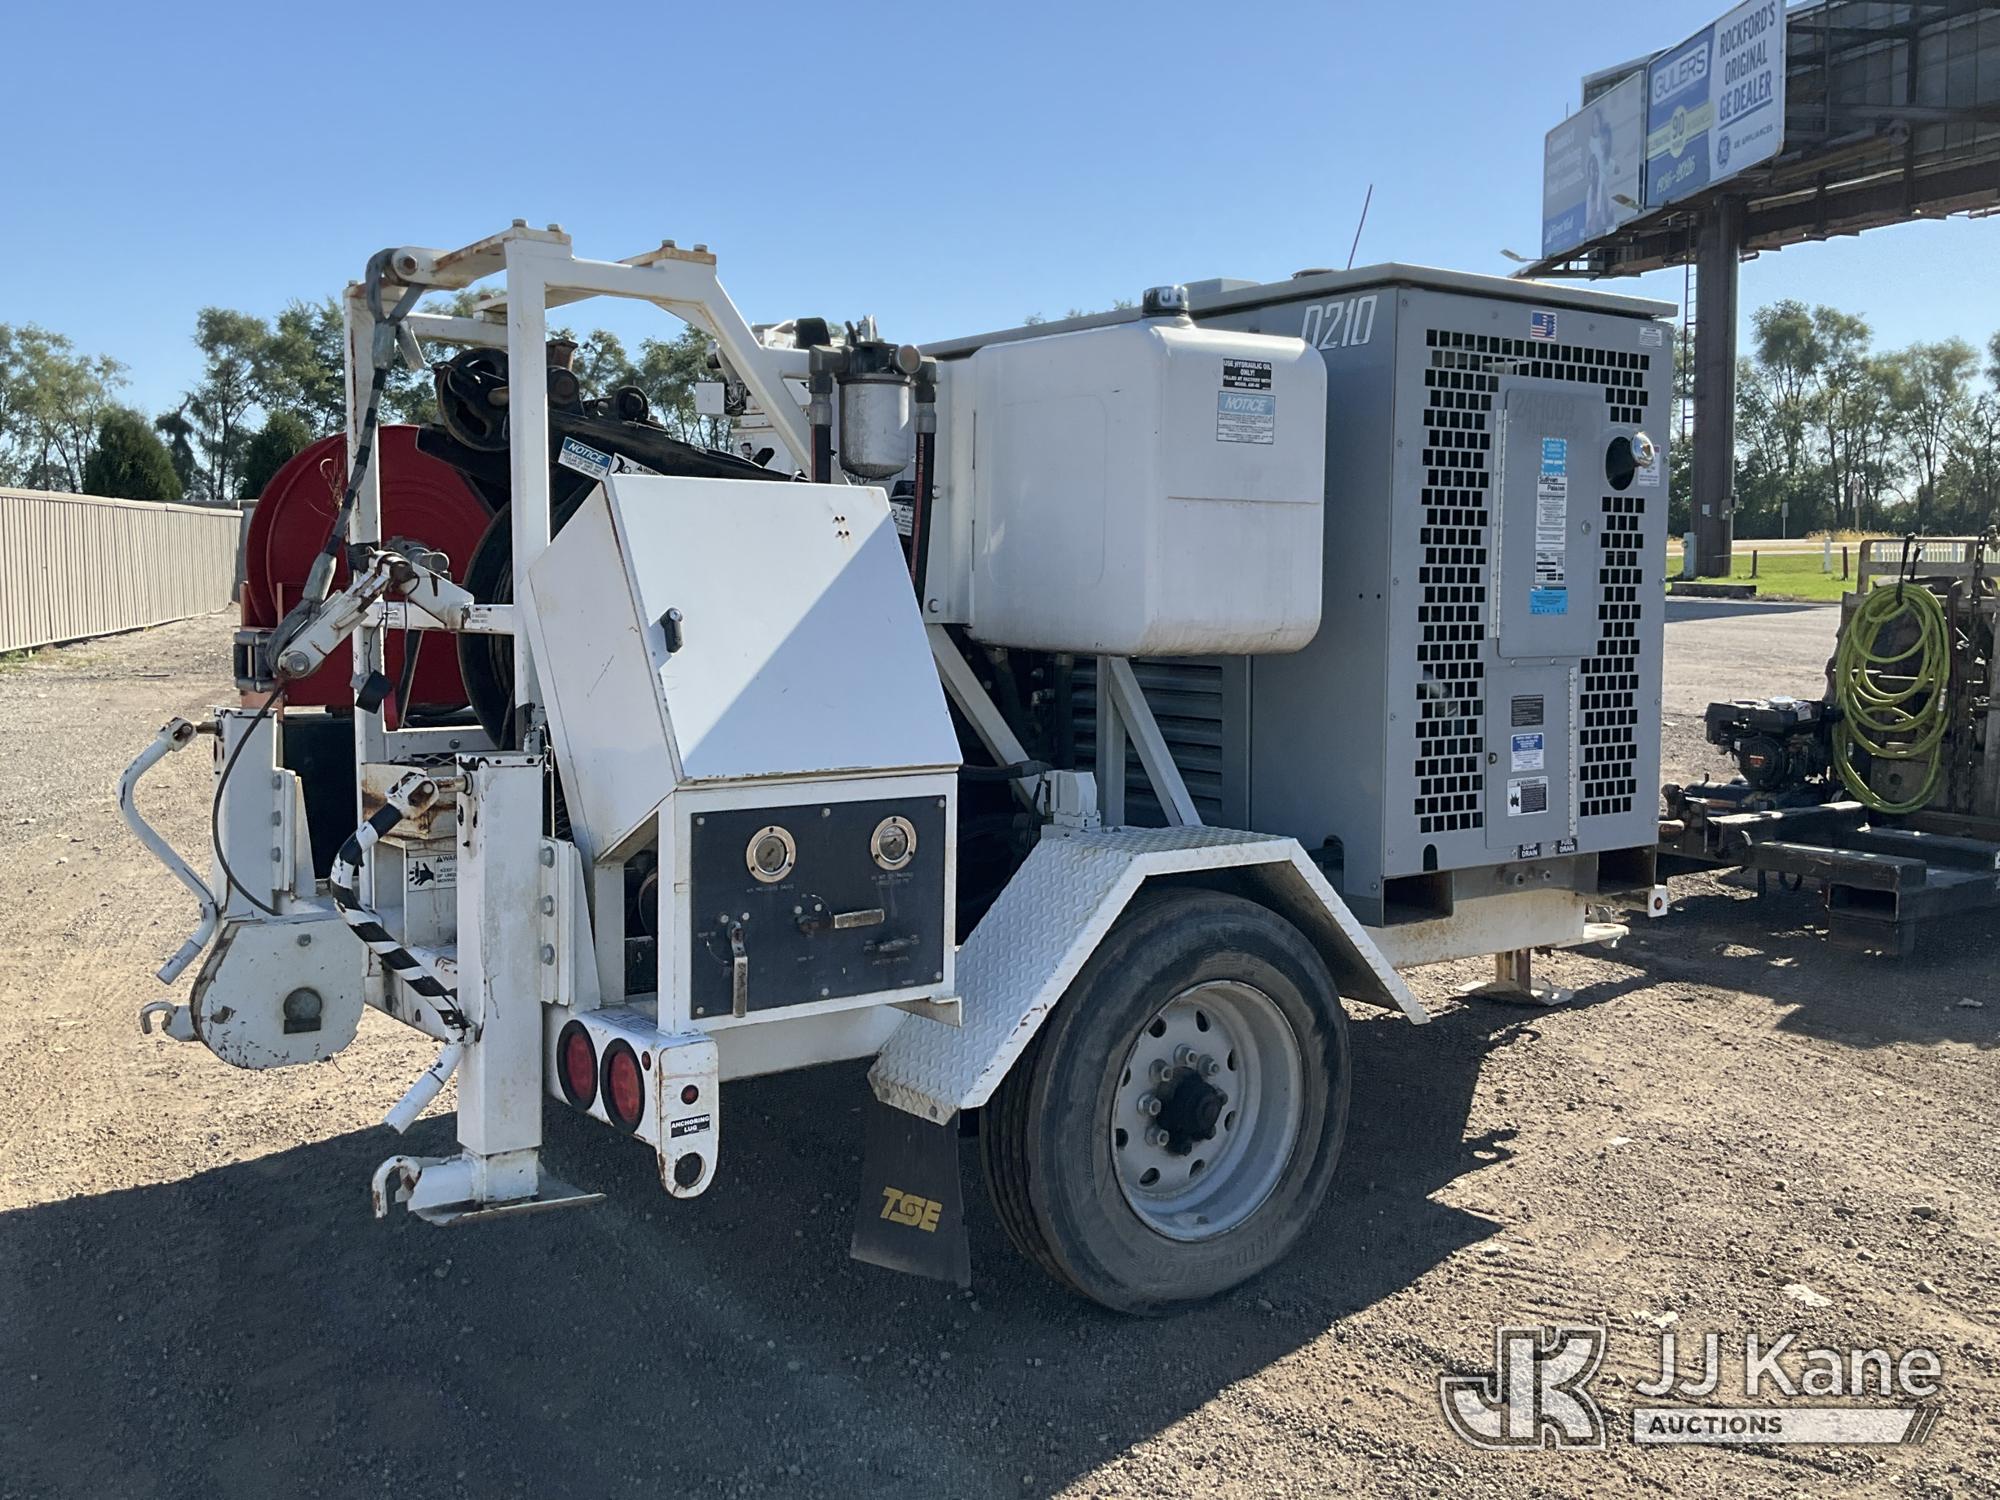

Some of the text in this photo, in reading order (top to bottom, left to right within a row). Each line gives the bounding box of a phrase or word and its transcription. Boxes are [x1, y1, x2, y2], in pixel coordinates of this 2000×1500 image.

[1719, 1, 1776, 58] ROCKFORD'S
[1724, 40, 1768, 86] ORIGINAL
[1654, 49, 1706, 99] GULERS
[1719, 95, 1732, 122] GE
[1733, 70, 1772, 116] DEALER
[1672, 111, 1685, 140] 90
[1234, 361, 1262, 370] HYDRAULIC
[1225, 396, 1267, 411] NOTICE
[568, 442, 605, 463] NOTICE
[1521, 849, 1538, 858] DRAIN
[1559, 845, 1575, 853] DRAIN
[671, 1115, 710, 1128] ANCHORING
[684, 1124, 697, 1133] LUG
[880, 1186, 943, 1233] TSE
